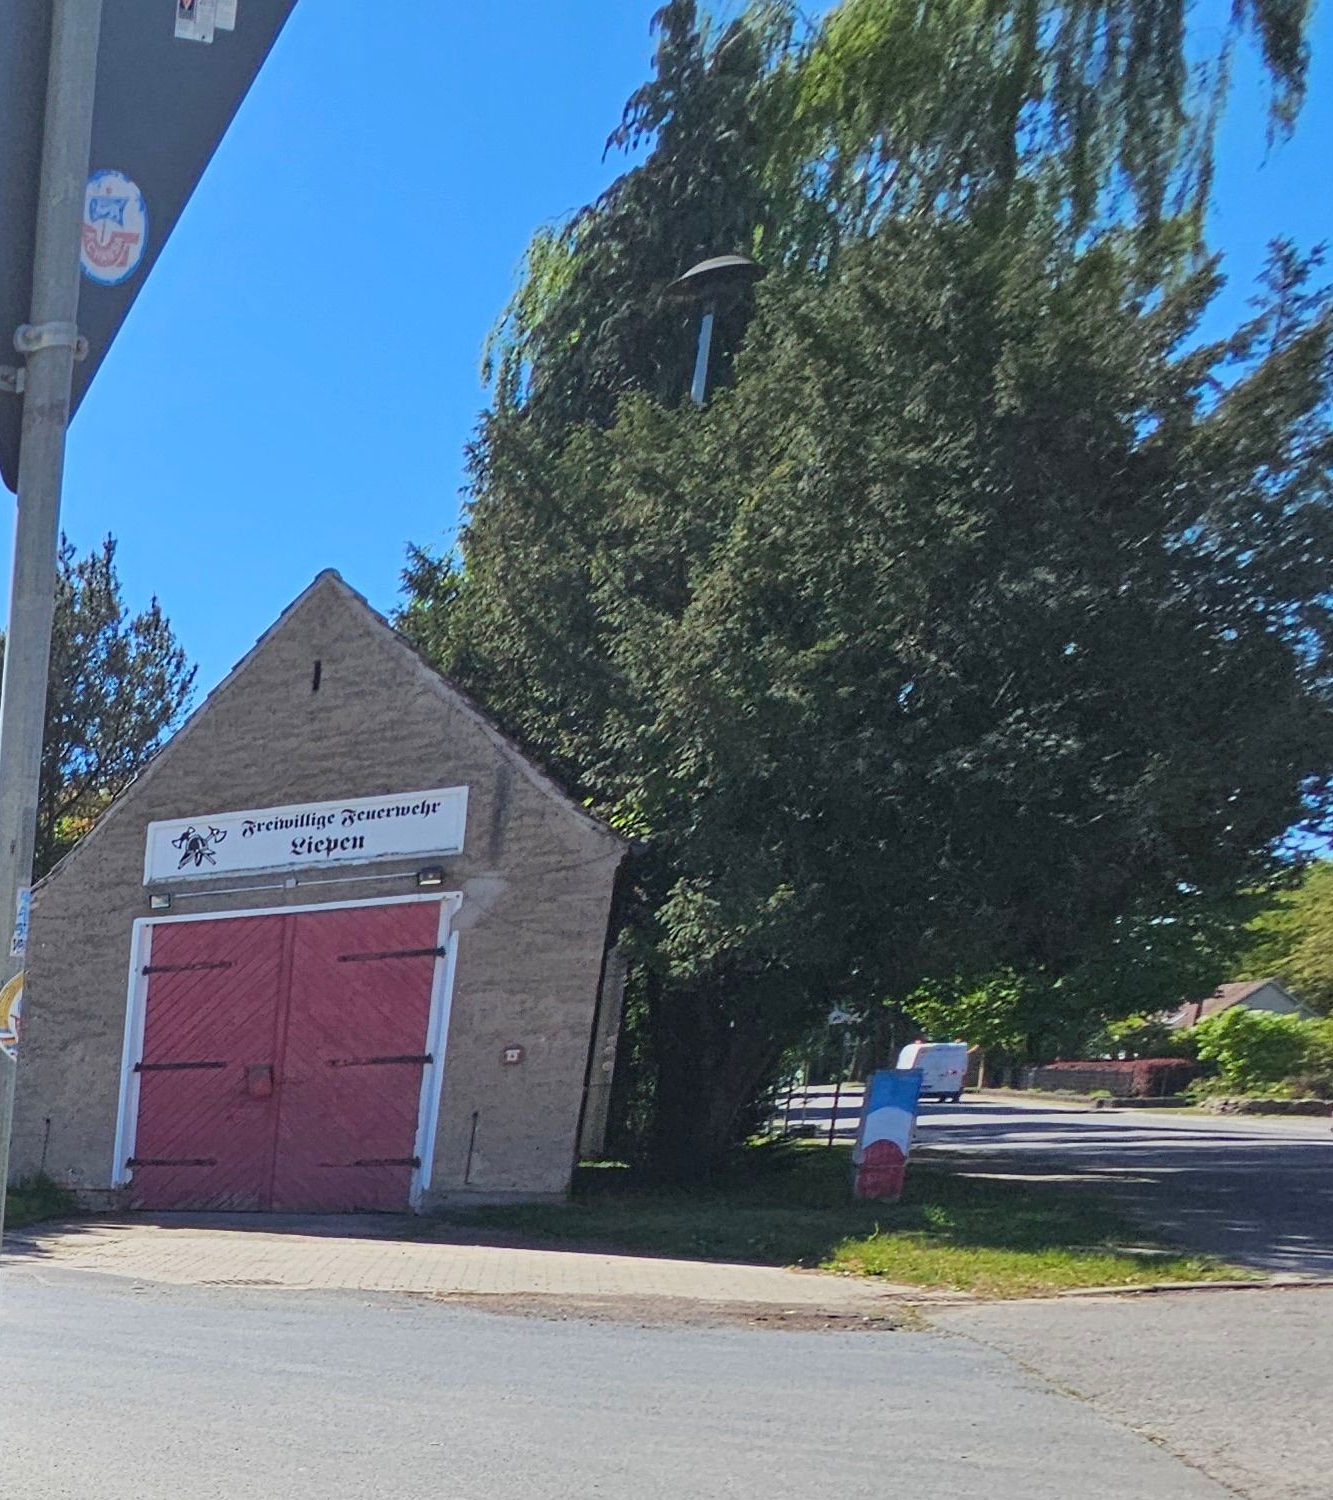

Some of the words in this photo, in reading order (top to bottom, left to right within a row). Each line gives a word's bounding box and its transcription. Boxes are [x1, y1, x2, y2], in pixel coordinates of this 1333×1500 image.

[241, 813, 335, 838] Freiwillige
[341, 800, 441, 827] Feuerwehr
[290, 835, 366, 858] Liepen
